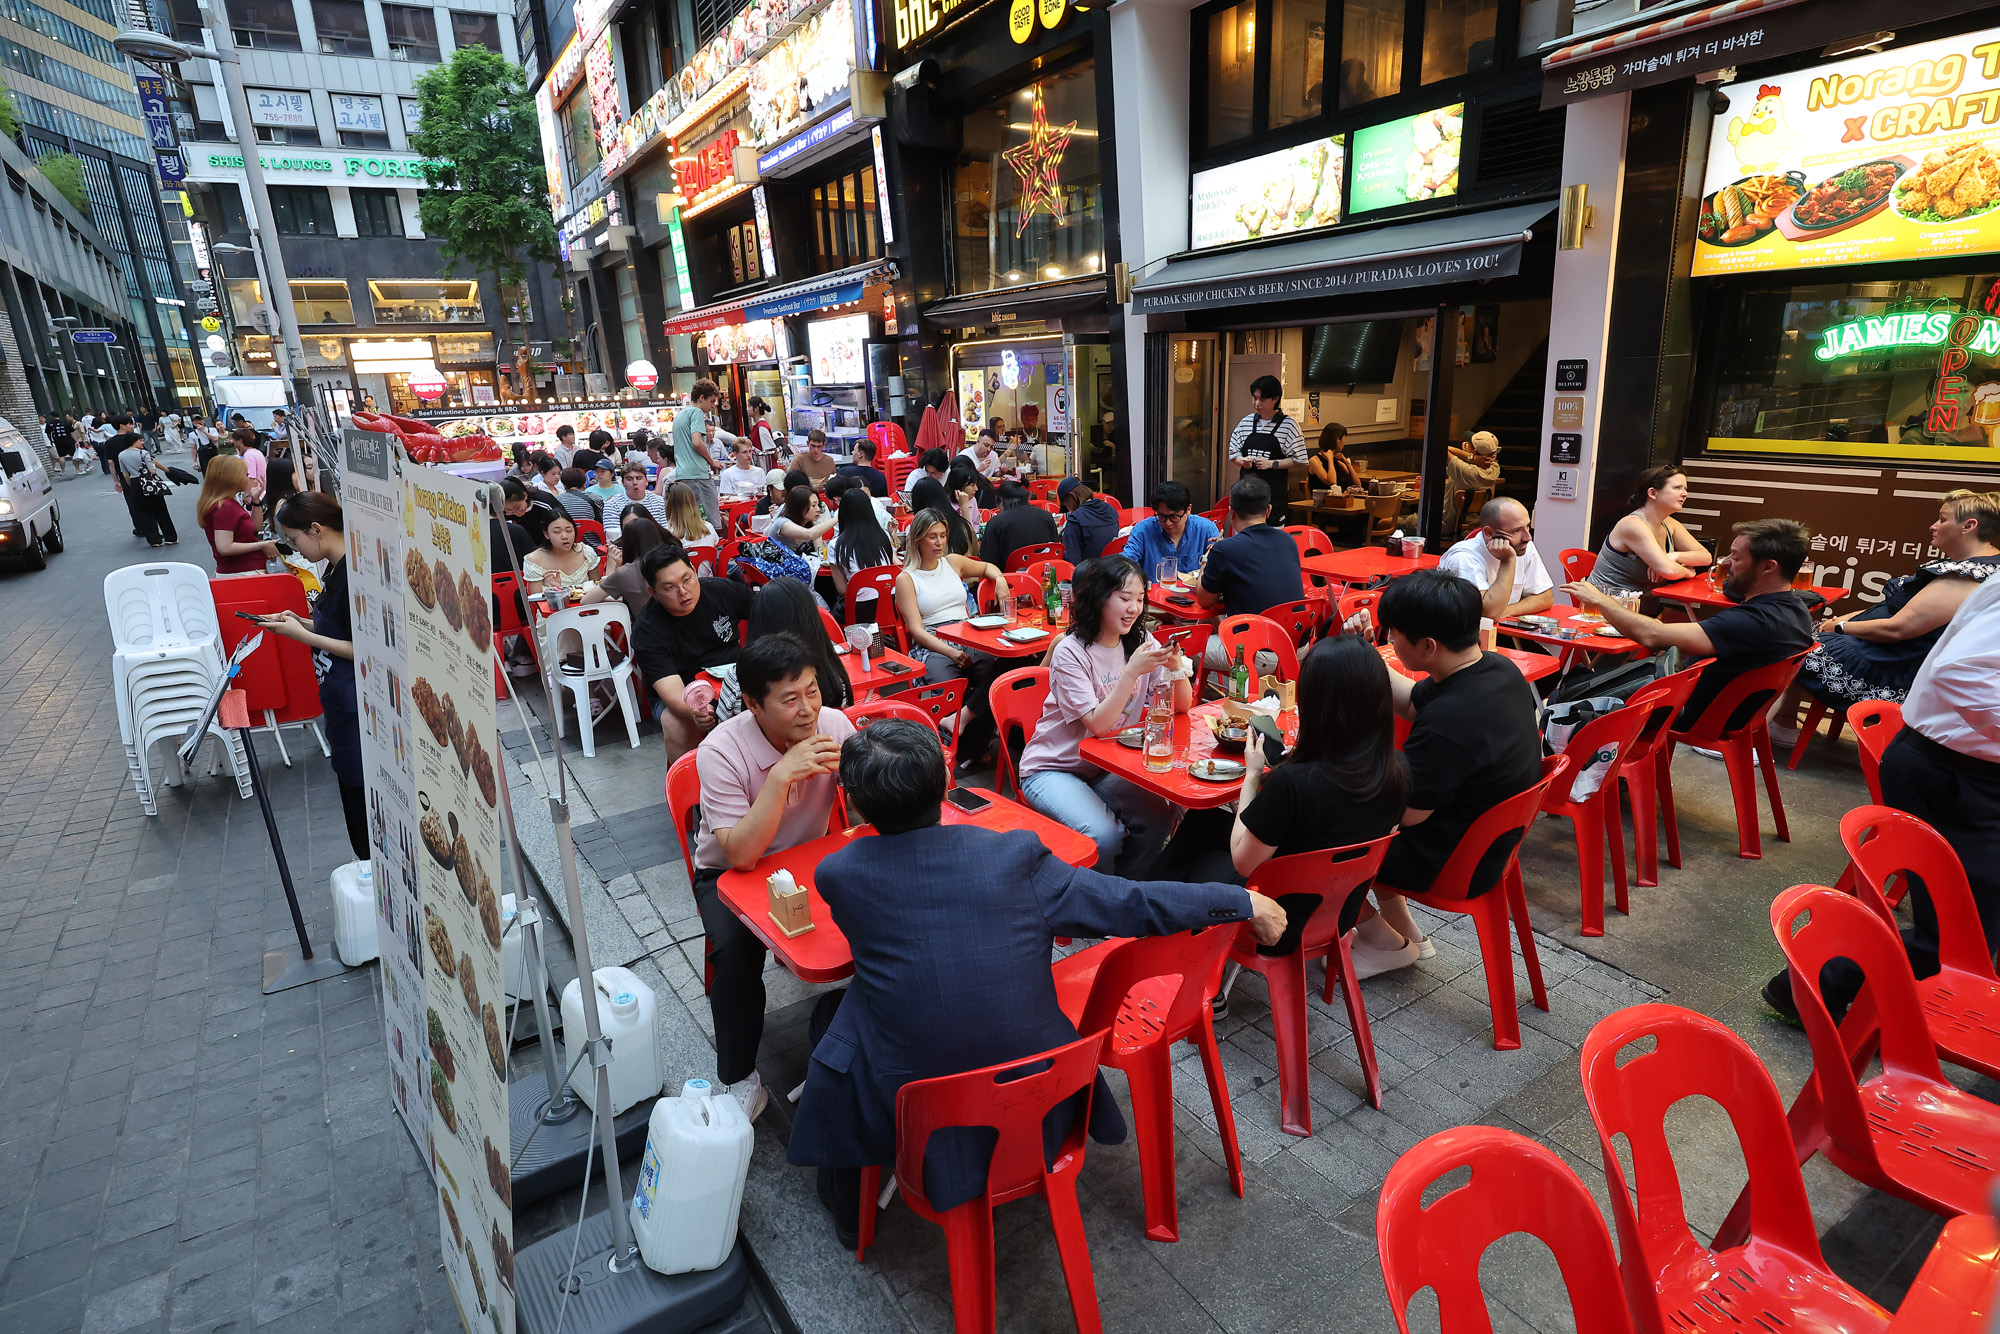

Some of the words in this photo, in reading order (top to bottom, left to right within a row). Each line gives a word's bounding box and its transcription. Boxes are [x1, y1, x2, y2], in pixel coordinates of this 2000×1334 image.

[1013, 6, 1030, 20] GOOD
[1044, 2, 1060, 15] ZONE
[1013, 17, 1031, 30] TASTE
[1563, 65, 1616, 94] 노랑통닭
[1622, 53, 1673, 76] 가마솥에
[1675, 44, 1700, 63] 튀겨
[1705, 41, 1718, 56] 더
[1722, 29, 1765, 51] 바삭한
[139, 80, 163, 95] 명동
[1807, 53, 1967, 111] Norang
[259, 93, 302, 112] 고시텔
[339, 96, 374, 111] 명동
[263, 113, 303, 122] 755-7880
[339, 111, 380, 128] 고시텔
[1870, 88, 2000, 141] CRAFT
[760, 153, 779, 171] Premium
[779, 141, 798, 161] Seafood
[798, 137, 807, 151] Bar
[1804, 154, 1834, 167] DRAFT
[208, 155, 269, 168] SHISA
[272, 157, 332, 171] LOUNGE
[1919, 230, 1945, 240] Crispy
[1946, 228, 1979, 237] Chicken
[1794, 242, 1813, 252] Spicy
[1815, 240, 1846, 250] Boneless
[1848, 237, 1877, 246] Chicken
[1878, 235, 1896, 243] Feet
[1915, 243, 1979, 255] クリスピーチキン
[1703, 251, 1729, 260] Sausage
[1736, 248, 1757, 256] French
[1143, 294, 1180, 307] PURADAK
[1182, 291, 1204, 303] SHOP
[1205, 287, 1247, 301] CHICKEN
[1248, 286, 1256, 296] &
[1258, 282, 1284, 296] BEER
[1291, 277, 1323, 292] SINCE
[1325, 275, 1347, 288] 2014
[1355, 265, 1414, 283] PURADAK
[1417, 259, 1462, 277] LOVES
[1465, 254, 1500, 271] YOU!
[763, 304, 778, 315] Premium
[779, 303, 793, 313] Seafood
[1928, 316, 1981, 432] OPEN
[418, 409, 433, 417] Beef
[434, 407, 464, 416] Intestines
[465, 405, 496, 417] Gopchang
[504, 405, 518, 413] BBQ
[1557, 401, 1580, 411] 100%
[413, 483, 437, 520] Norang
[437, 491, 467, 527] Chicken
[1855, 537, 1897, 557] 튀겨
[1902, 542, 1922, 559] 더
